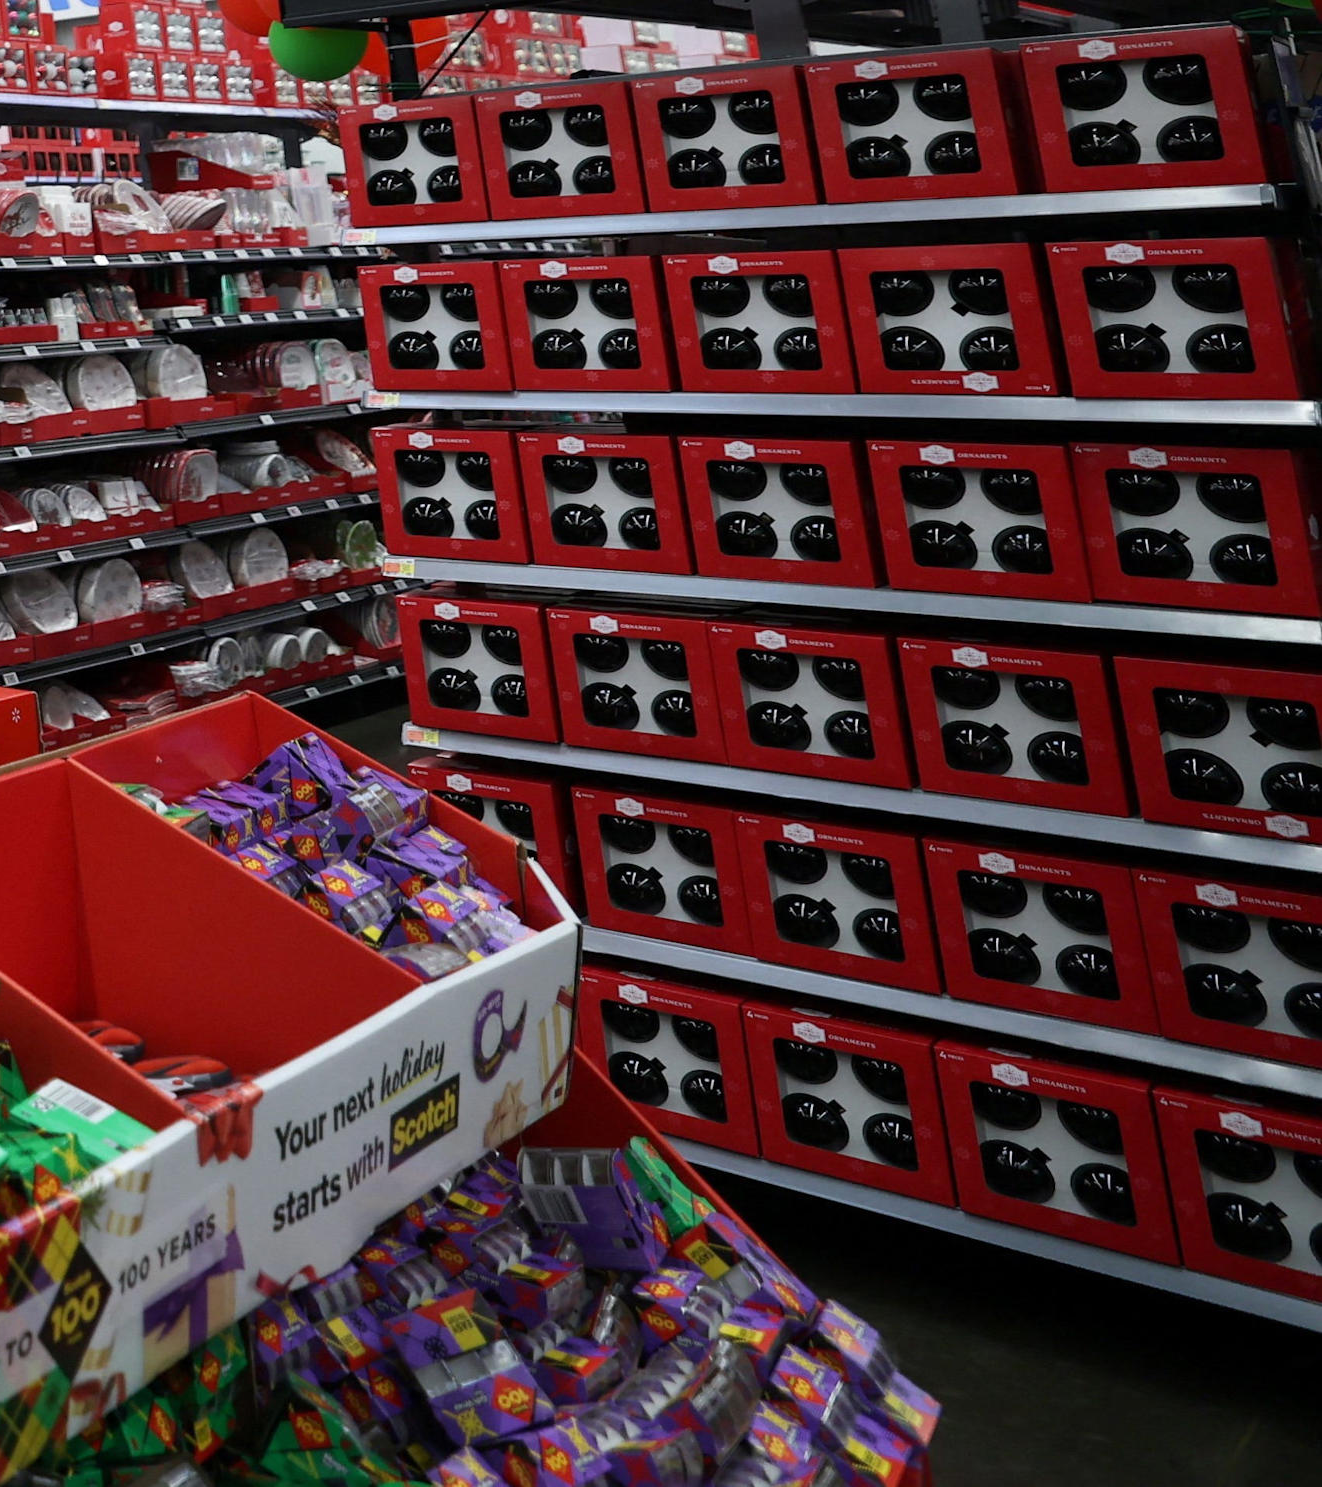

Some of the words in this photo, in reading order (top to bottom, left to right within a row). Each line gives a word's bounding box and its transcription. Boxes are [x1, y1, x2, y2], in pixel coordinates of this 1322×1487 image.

[1119, 41, 1173, 50] ORNAMENTS
[991, 657, 1042, 666] ORNAMENTS
[1203, 813, 1261, 825] ORNAMENTS
[298, 838, 317, 858] 100
[1018, 864, 1071, 876] ORNAMENTS
[1241, 896, 1301, 910] ORNAMENTS
[1032, 1077, 1086, 1093] ORNAMENTS
[275, 1112, 327, 1161] Your
[333, 1078, 375, 1132] next
[380, 1040, 445, 1101] holiday
[273, 1175, 341, 1232] starts
[346, 1135, 384, 1193] with
[392, 1088, 457, 1155] Scotch
[118, 1256, 150, 1294] 100
[157, 1215, 216, 1269] YEARS
[50, 1283, 101, 1343] 100
[646, 1313, 677, 1330] 100
[259, 1324, 279, 1341] 100
[6, 1332, 34, 1364] TO
[497, 1388, 529, 1406] 100
